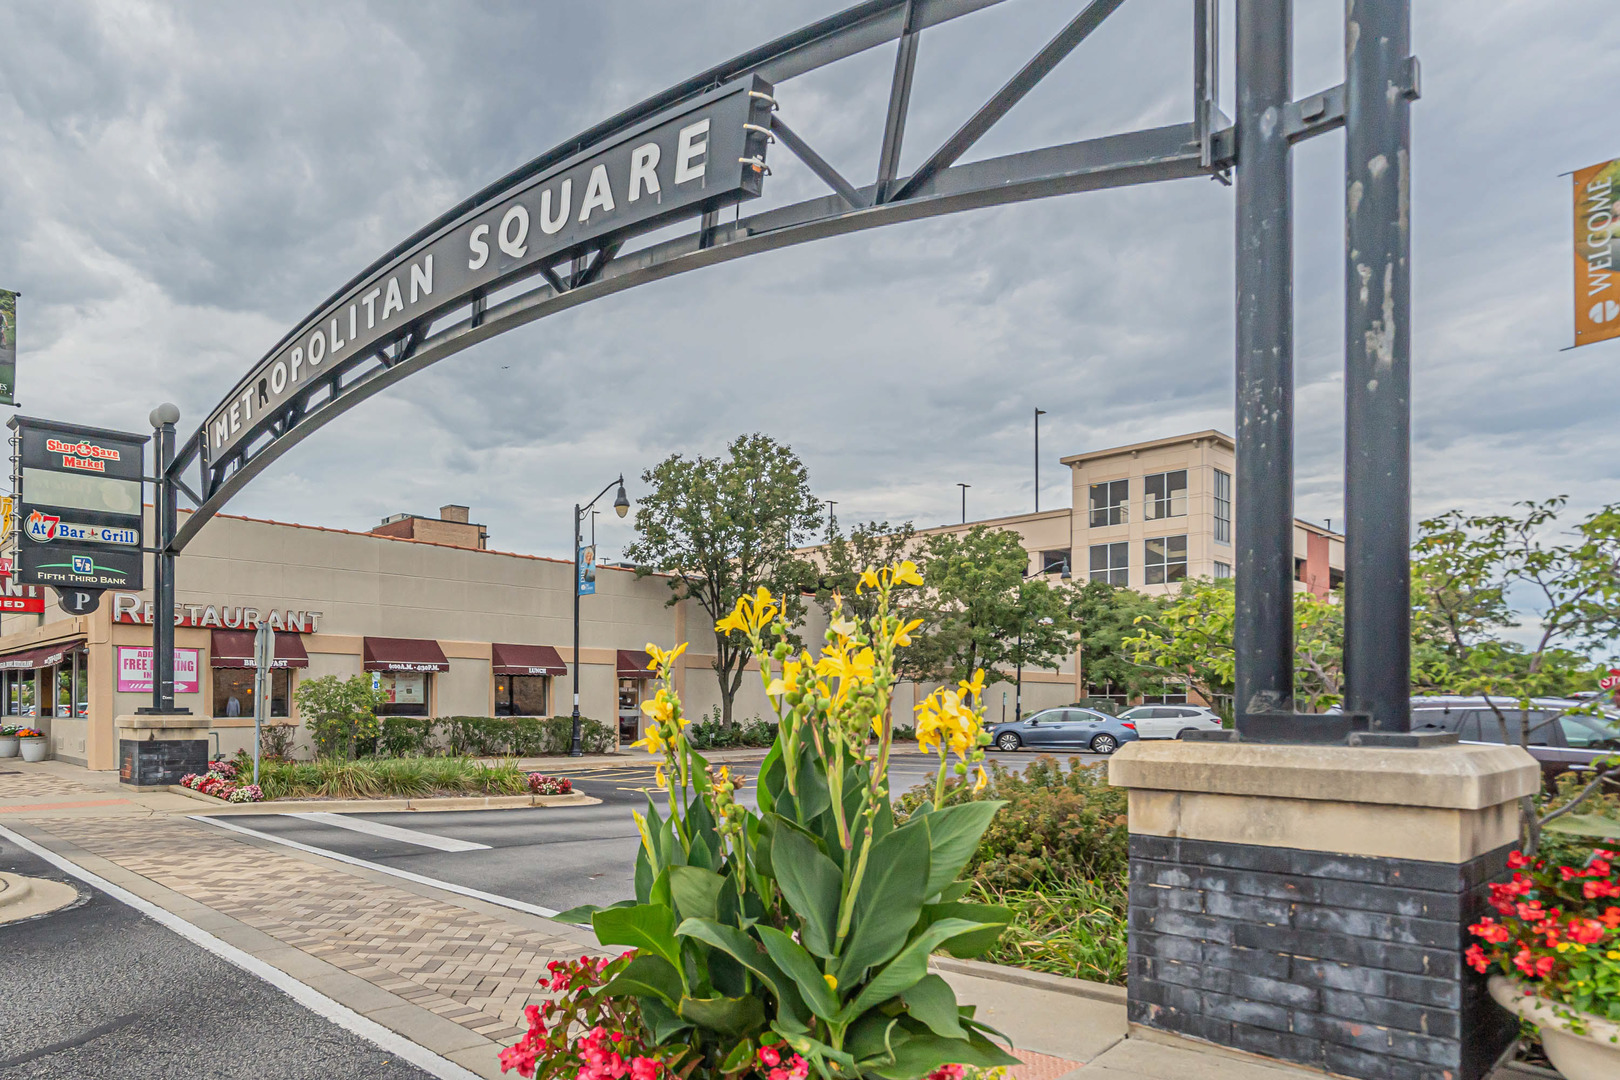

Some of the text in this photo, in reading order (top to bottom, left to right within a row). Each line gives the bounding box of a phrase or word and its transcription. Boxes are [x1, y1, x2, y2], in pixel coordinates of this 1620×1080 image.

[1587, 176, 1613, 296] WELCOME
[215, 118, 712, 449] METROPOLITAN SQUARE
[63, 456, 105, 472] Market
[60, 525, 86, 539] Bar
[101, 529, 134, 543] Grill
[37, 572, 126, 585] FIFTH THIRD BANK
[74, 592, 90, 610] P
[114, 592, 323, 633] RESTAURANT
[123, 658, 148, 670] FREE
